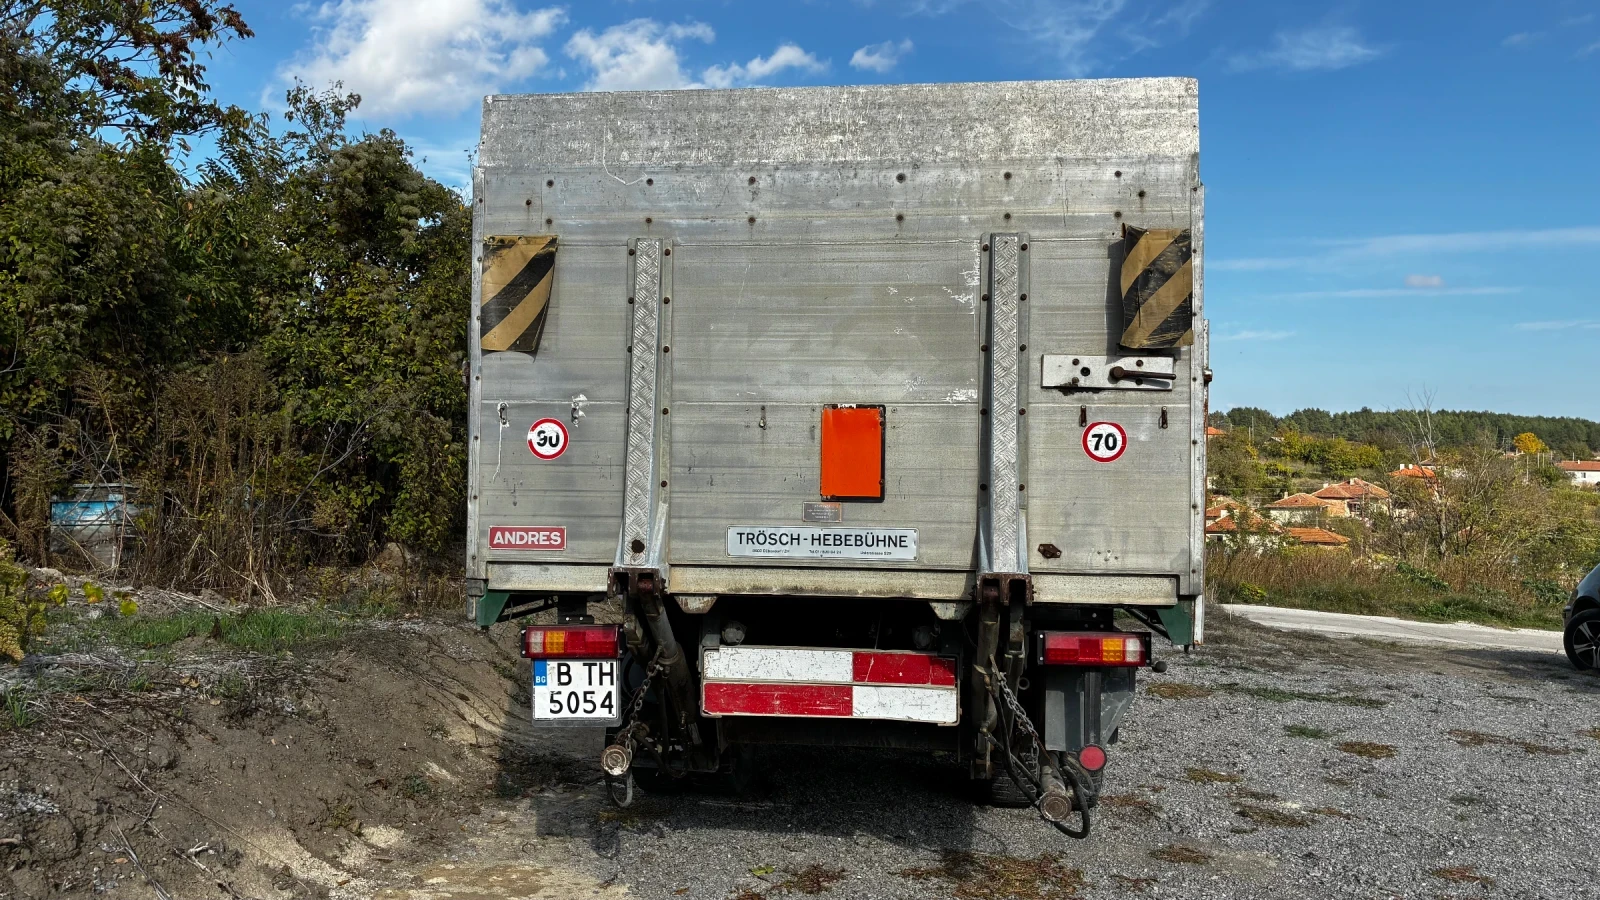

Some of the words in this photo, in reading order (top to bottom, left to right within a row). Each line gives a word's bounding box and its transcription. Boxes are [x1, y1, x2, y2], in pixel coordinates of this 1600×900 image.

[1091, 432, 1118, 451] 70
[493, 531, 562, 545] ANDRES
[535, 675, 546, 683] BG
[557, 662, 573, 686] B
[582, 662, 614, 686] TH
[549, 691, 614, 714] 5054
